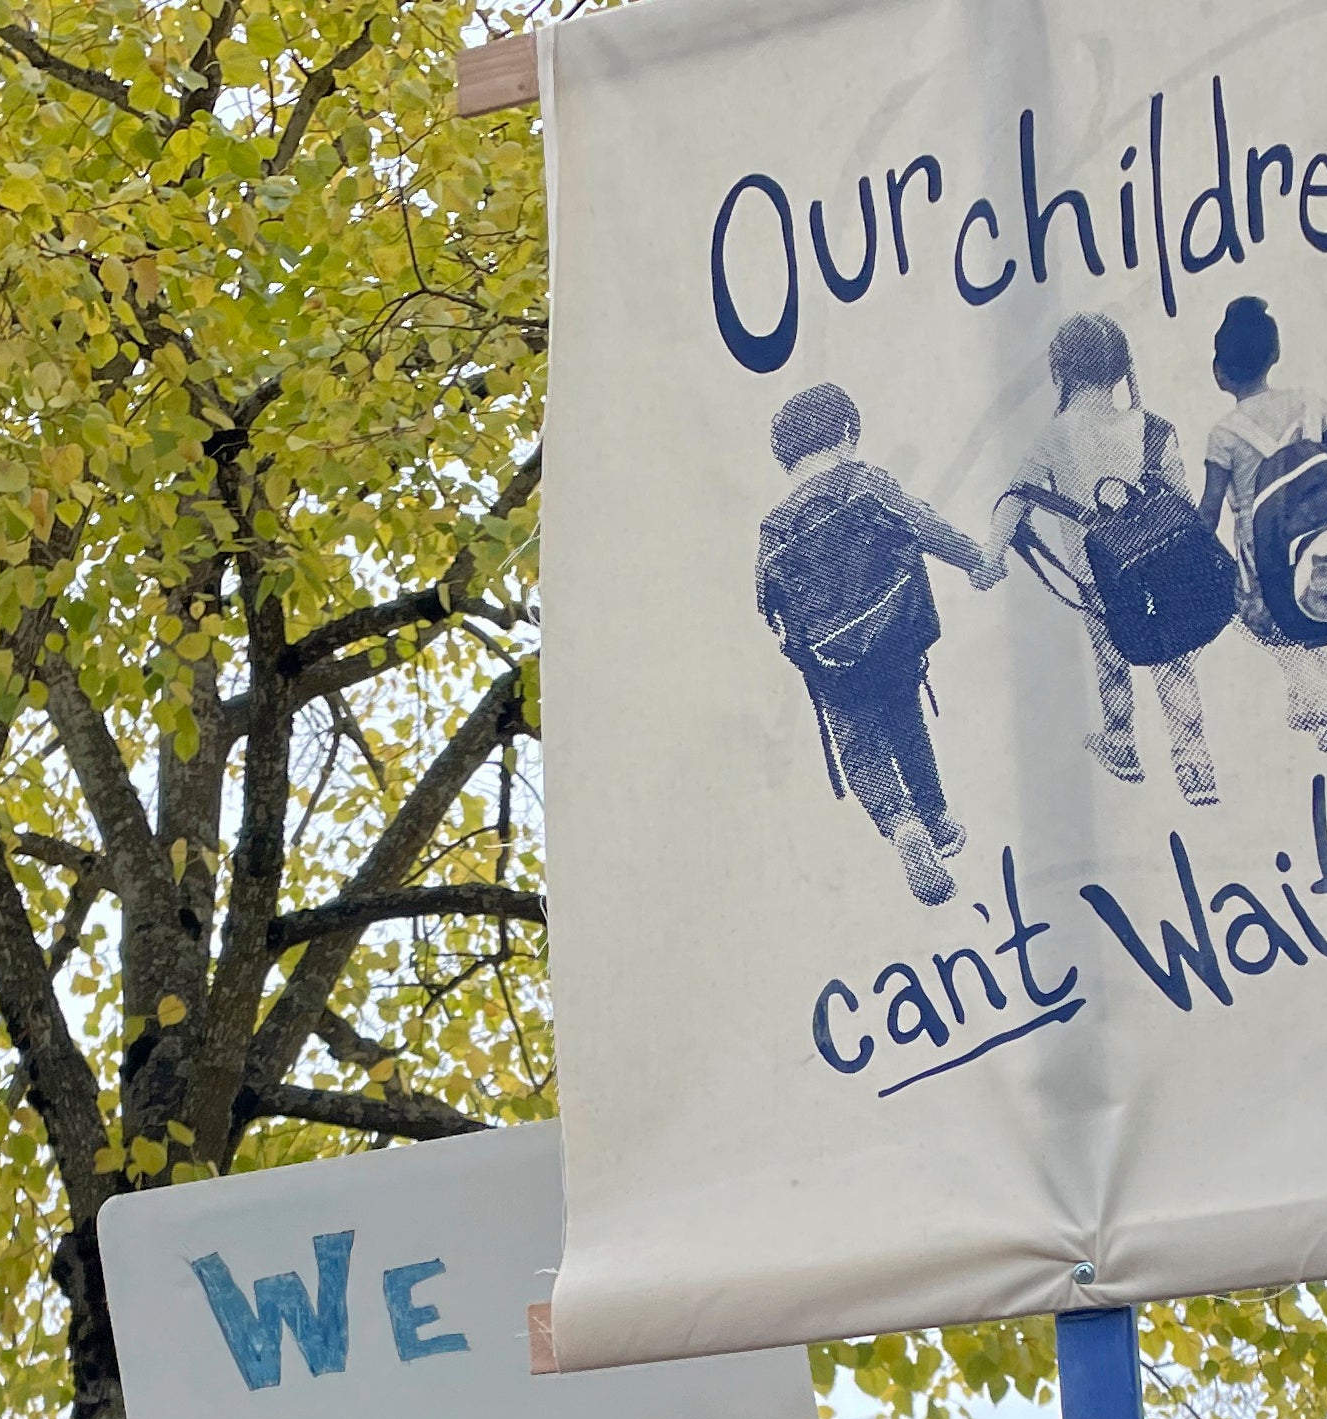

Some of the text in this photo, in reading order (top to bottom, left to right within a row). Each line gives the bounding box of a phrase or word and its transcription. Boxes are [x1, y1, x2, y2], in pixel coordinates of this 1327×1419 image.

[711, 154, 942, 374] Our
[812, 845, 1077, 1075] can't
[189, 1229, 471, 1391] WE
